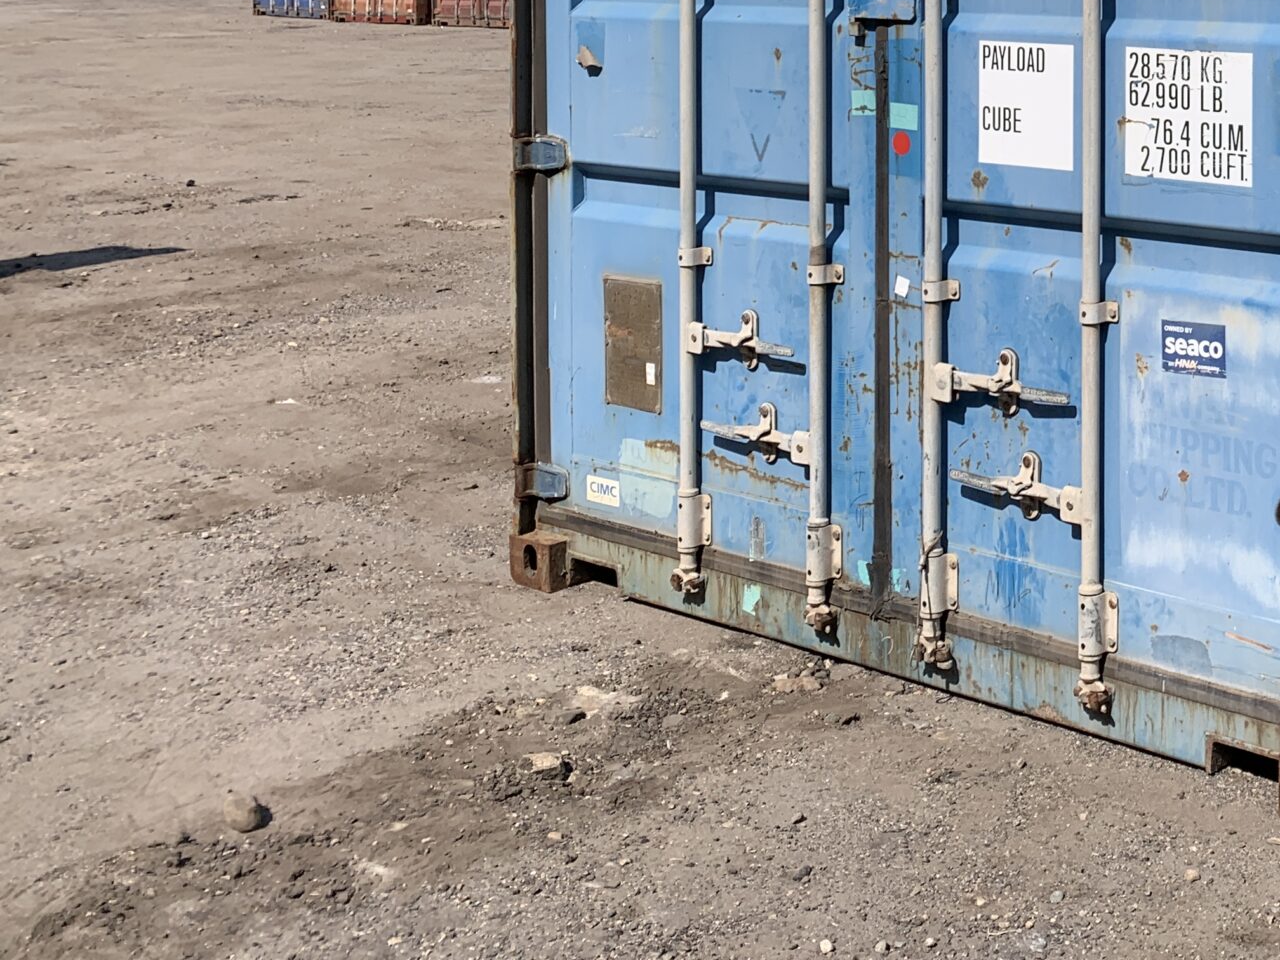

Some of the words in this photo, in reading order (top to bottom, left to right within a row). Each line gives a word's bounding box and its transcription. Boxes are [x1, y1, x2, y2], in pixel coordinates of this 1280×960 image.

[982, 44, 1046, 73] PAYLOAD
[1129, 52, 1191, 82] 28,570
[1200, 55, 1228, 85] KG.
[1129, 81, 1191, 111] 62,990
[1200, 85, 1228, 114] LB.
[982, 105, 1022, 134] CUBE
[1151, 117, 1191, 147] 76.4
[1200, 121, 1248, 153] CU.M.
[1140, 145, 1191, 176] 2,700
[1200, 150, 1248, 182] CU.FT.
[1163, 324, 1184, 333] OWNED
[1164, 336, 1223, 359] seaco
[590, 481, 617, 498] CIMC
